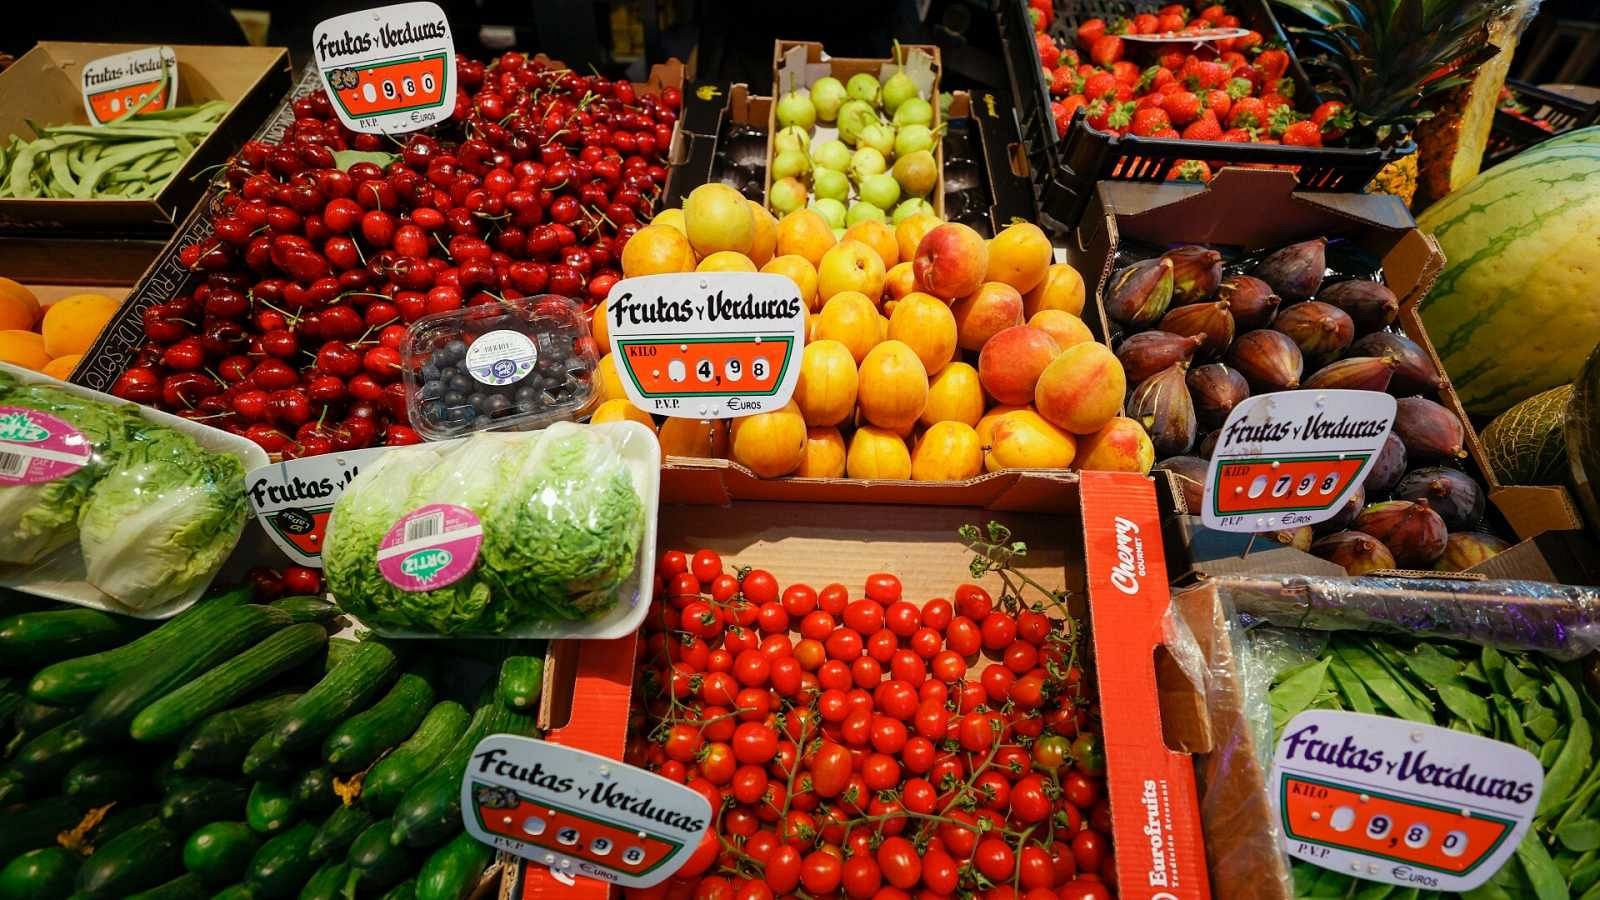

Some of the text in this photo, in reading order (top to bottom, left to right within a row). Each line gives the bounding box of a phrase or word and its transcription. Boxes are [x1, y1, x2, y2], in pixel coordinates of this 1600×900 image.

[316, 20, 446, 62] Frutas Y Verduras
[84, 66, 123, 87] Frutas
[608, 290, 801, 328] Frutas Y Verduras
[630, 346, 657, 357] KILO
[698, 360, 763, 385] 4,98
[655, 399, 680, 409] P.V.P.
[1224, 412, 1388, 448] Frutas Y Verduras
[247, 476, 344, 508] Frutas Y
[405, 551, 450, 572] ORTIZ
[1111, 515, 1140, 595] Cherry
[1135, 536, 1146, 577] GOURMET
[1283, 724, 1535, 804] Frutas Y Verduras
[474, 749, 704, 834] Frutas Y Verduras
[1160, 779, 1172, 831] Artesanal
[1291, 783, 1329, 800] KILO
[1141, 779, 1168, 888] Eurofruits
[1369, 815, 1458, 849] 9,80
